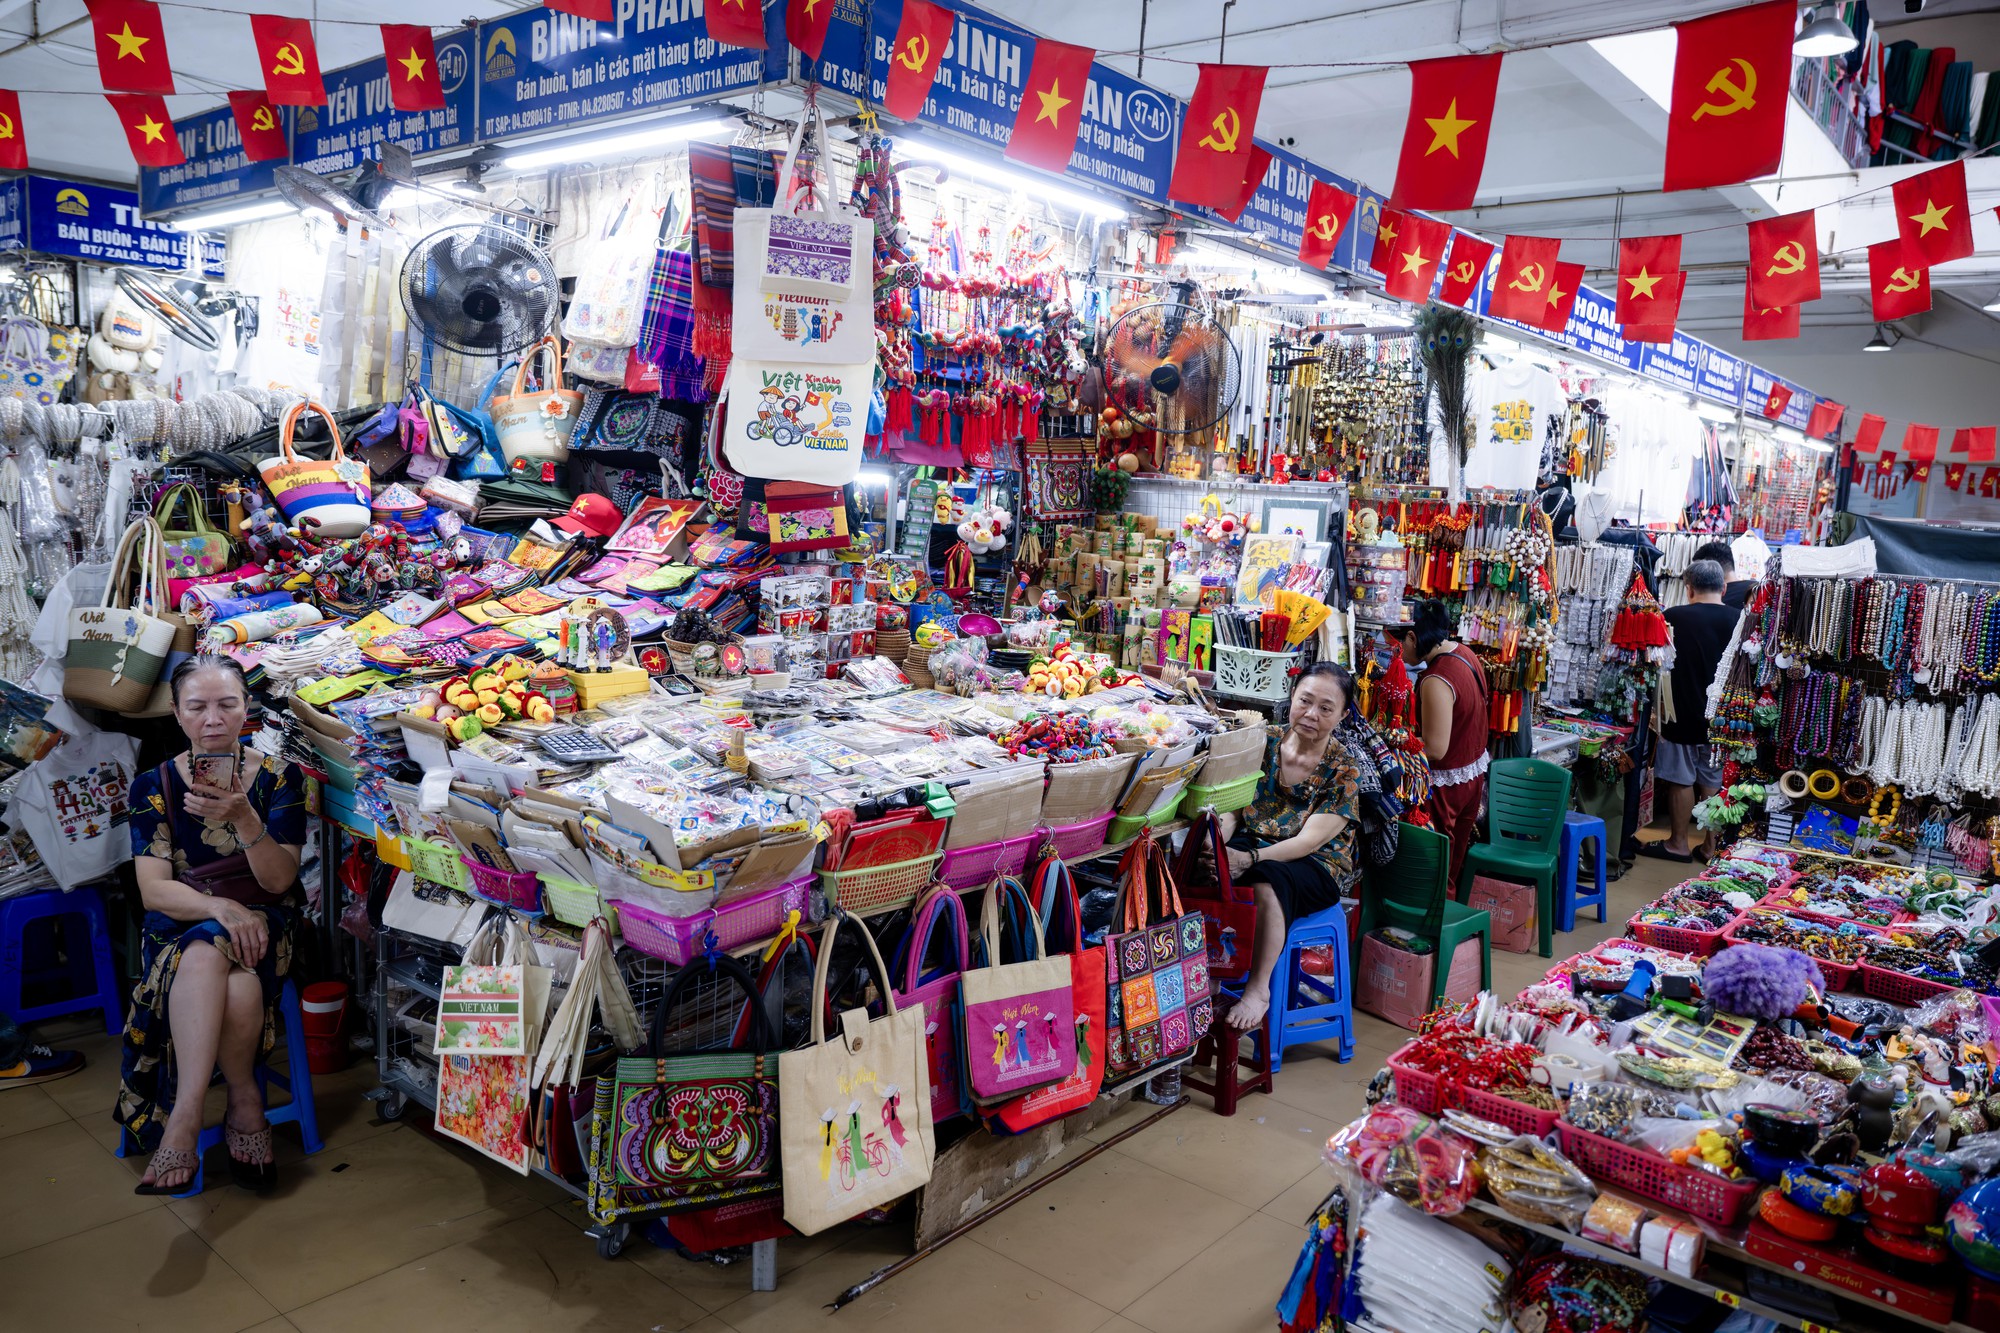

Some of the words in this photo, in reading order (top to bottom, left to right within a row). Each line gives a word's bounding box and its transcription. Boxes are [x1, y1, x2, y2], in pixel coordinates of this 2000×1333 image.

[532, 9, 597, 62] BÌNH
[942, 13, 1021, 89] ÌNH
[516, 78, 536, 102] Bán
[539, 72, 569, 96] buôn,
[572, 64, 592, 89] bán
[595, 57, 606, 83] lẻ
[609, 55, 629, 81] các
[633, 46, 656, 76] mặt
[659, 41, 689, 67] hàng
[694, 37, 715, 64] tạp
[327, 77, 358, 126] YẾN
[430, 109, 445, 129] hoa
[446, 104, 458, 126] tai
[495, 115, 511, 136] SẠP:
[512, 107, 552, 130] 04.9280416
[961, 71, 988, 101] bán
[992, 81, 1006, 108] lẻ
[1093, 124, 1111, 151] tạp
[1113, 133, 1145, 162] phẩm
[1134, 99, 1165, 133] 37-A1
[58, 222, 89, 242] BÁN
[140, 233, 169, 252] BÁN
[790, 241, 810, 251] VIET
[811, 246, 831, 254] NAM
[103, 247, 144, 262] ZALO:
[146, 253, 179, 267] 0949
[762, 370, 803, 393] Việt
[804, 436, 848, 451] VIETNAM
[79, 611, 106, 625] Việt
[82, 629, 113, 643] Nam
[459, 1002, 478, 1013] VIET
[480, 1002, 500, 1013] NAM
